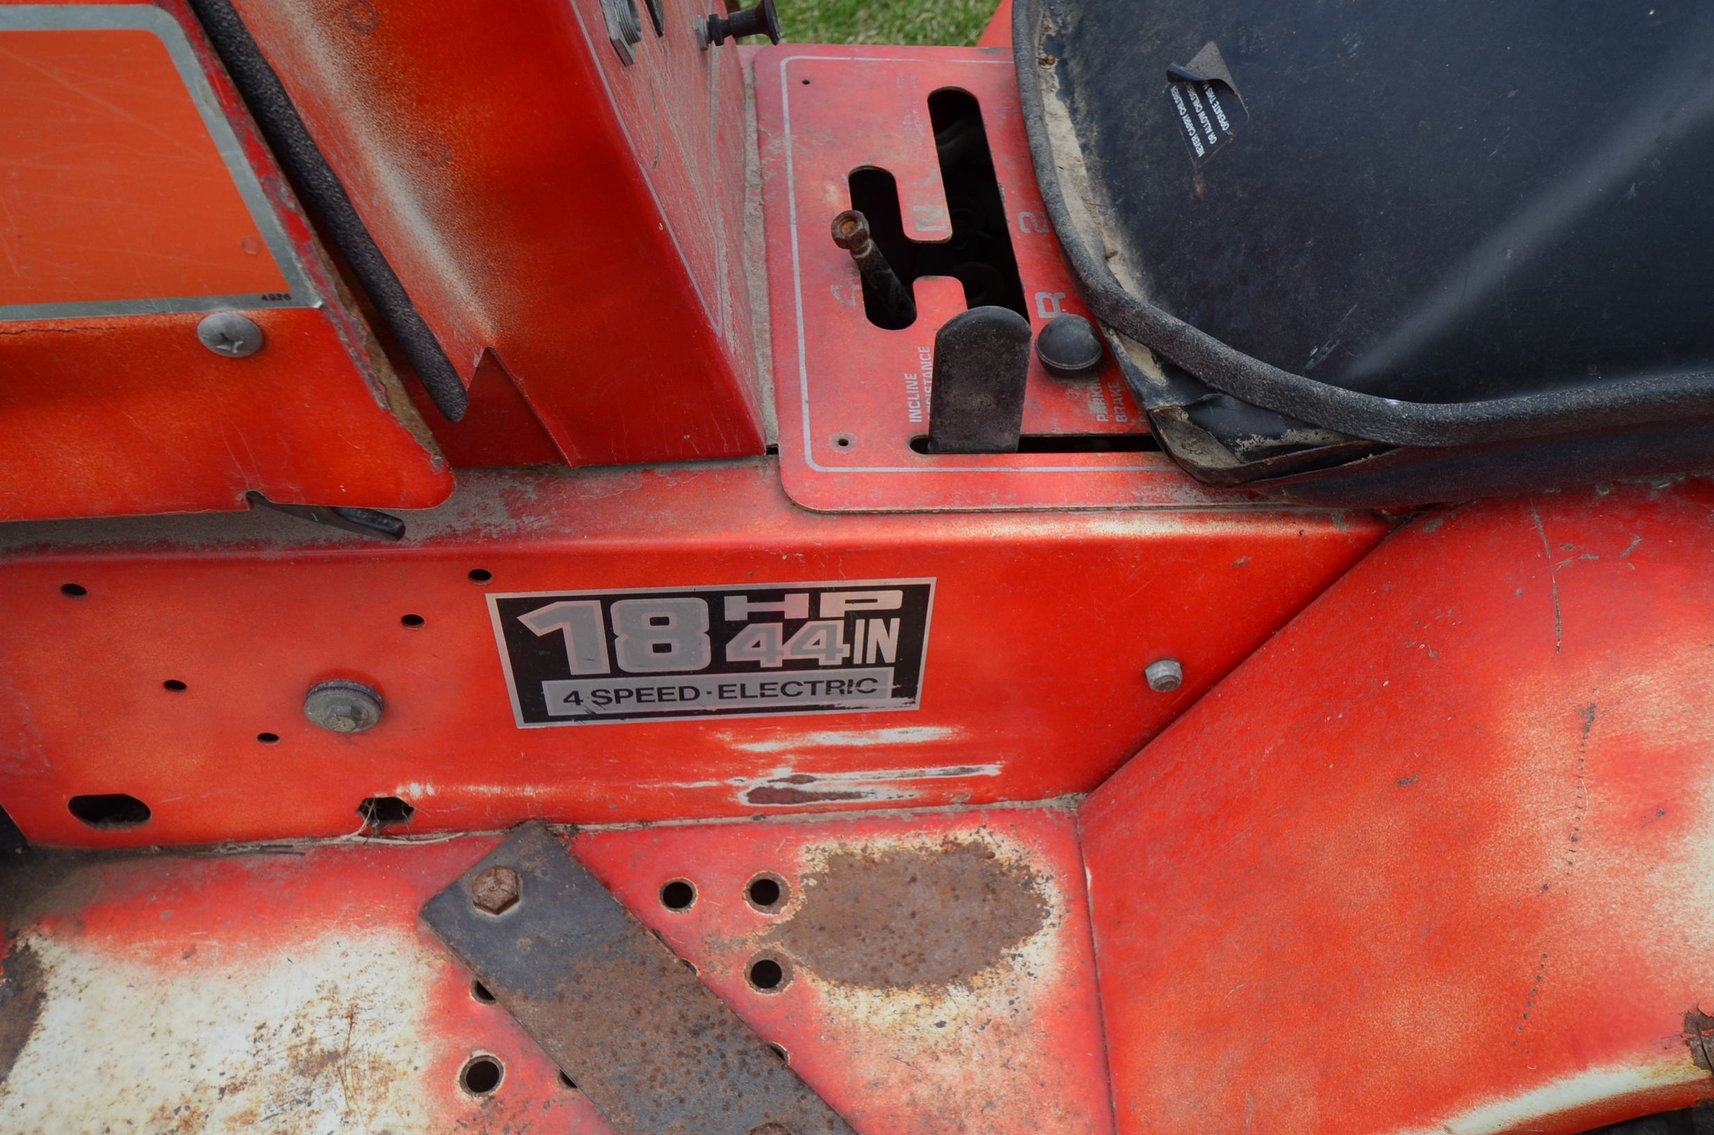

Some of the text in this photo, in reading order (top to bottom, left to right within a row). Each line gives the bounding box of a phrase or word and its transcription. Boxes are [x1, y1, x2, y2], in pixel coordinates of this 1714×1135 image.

[1170, 85, 1206, 158] NEVER CARRY CHILDREN
[1198, 112, 1214, 135] ALLOW
[1211, 100, 1230, 131] OPERATE
[1207, 131, 1217, 144] OR
[1018, 210, 1050, 234] 2
[1034, 291, 1067, 319] R
[904, 372, 923, 424] INCLINE
[1107, 381, 1129, 423] BRAKE
[516, 589, 904, 677] 18 HP
[562, 689, 585, 708] 4
